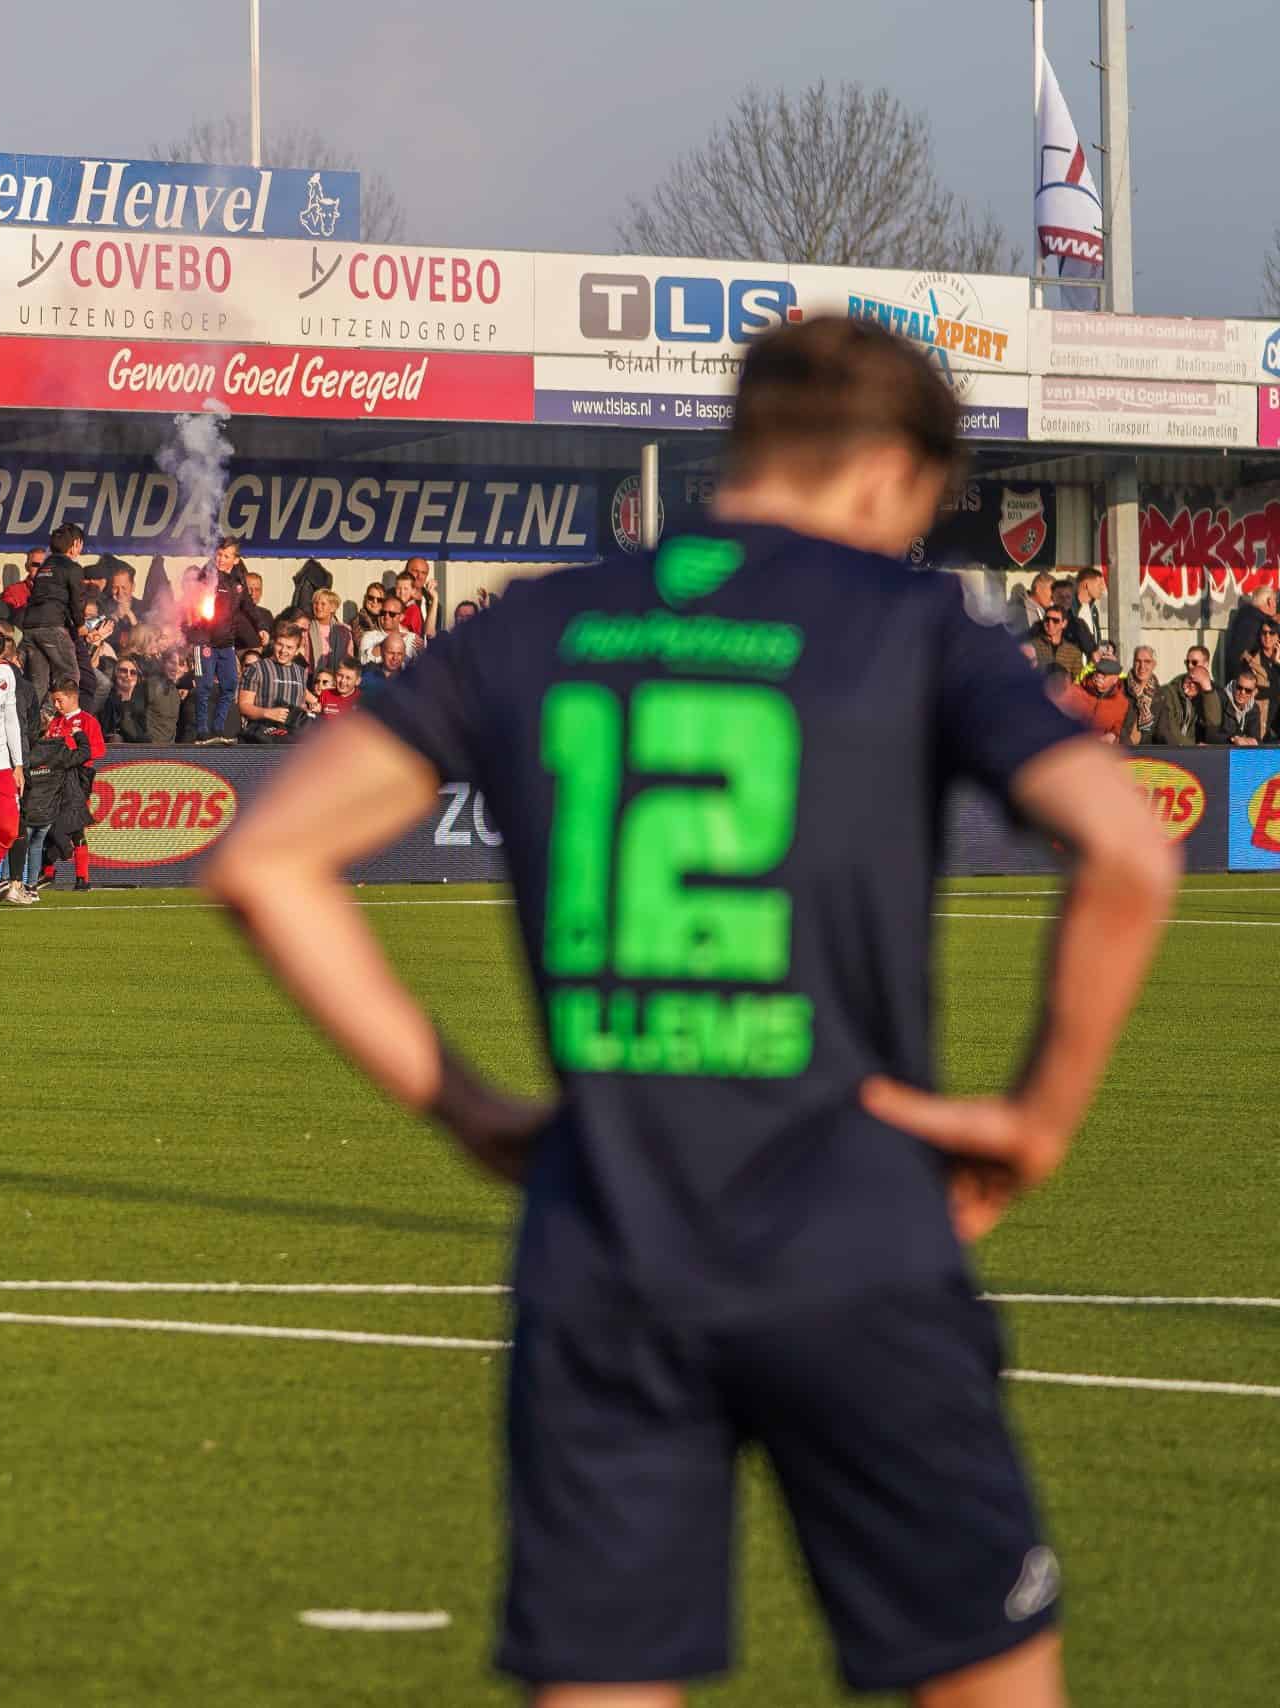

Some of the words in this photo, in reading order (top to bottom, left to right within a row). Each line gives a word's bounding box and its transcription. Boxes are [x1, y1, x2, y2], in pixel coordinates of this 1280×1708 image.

[68, 159, 274, 233] Heuvel
[69, 239, 232, 293] COVEBO
[347, 252, 501, 304] COVEBO
[19, 304, 229, 333] UITZENDGROEP
[299, 315, 497, 343] UITZENDGROEP
[592, 283, 783, 336] TLS
[1055, 319, 1082, 335] van
[108, 348, 216, 394] Gewoon
[223, 352, 294, 398] Goed
[300, 355, 429, 412] Geregeld
[604, 345, 660, 375] Totaal
[667, 349, 684, 372] in
[572, 397, 652, 417] www.tlslas.nl
[1045, 386, 1072, 399] van
[1075, 384, 1136, 401] HAPPEN
[87, 780, 228, 830] Daans
[540, 678, 804, 985] 12
